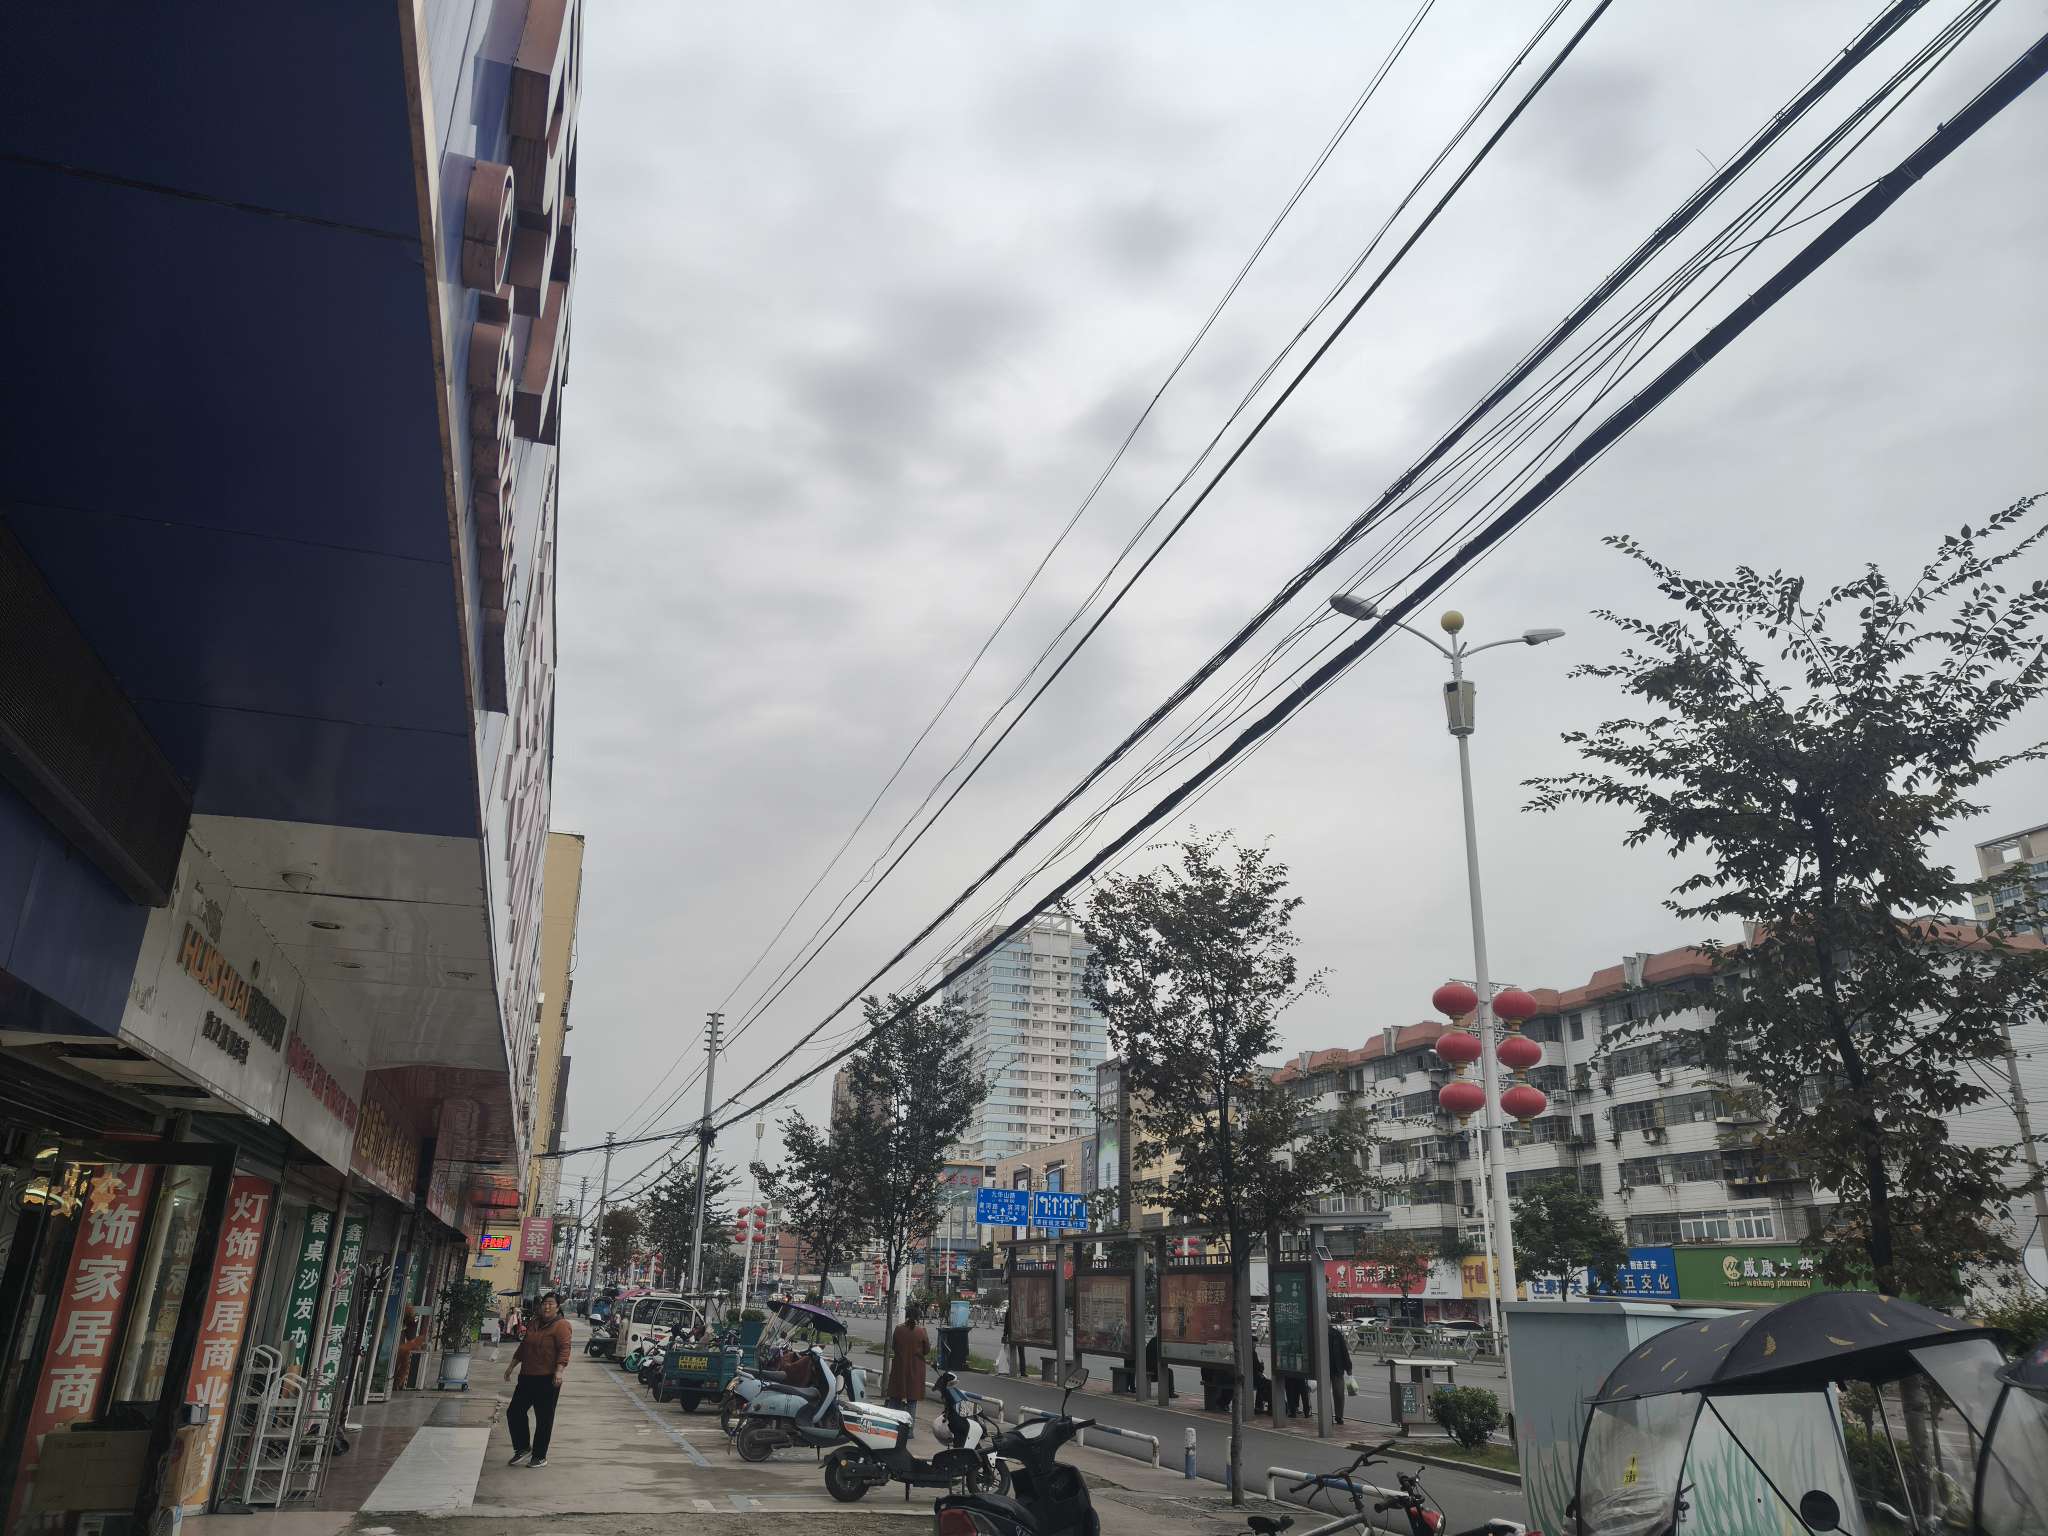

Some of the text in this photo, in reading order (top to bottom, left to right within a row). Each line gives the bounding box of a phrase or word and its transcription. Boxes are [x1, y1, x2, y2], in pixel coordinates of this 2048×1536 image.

[526, 1219, 547, 1258] 三轮车
[1743, 1256, 1828, 1279] 威康大药
[1777, 1280, 1811, 1289] pharmacy
[40, 1164, 147, 1450] 灯饰家居商
[289, 1211, 329, 1369] 餐桌沙发办
